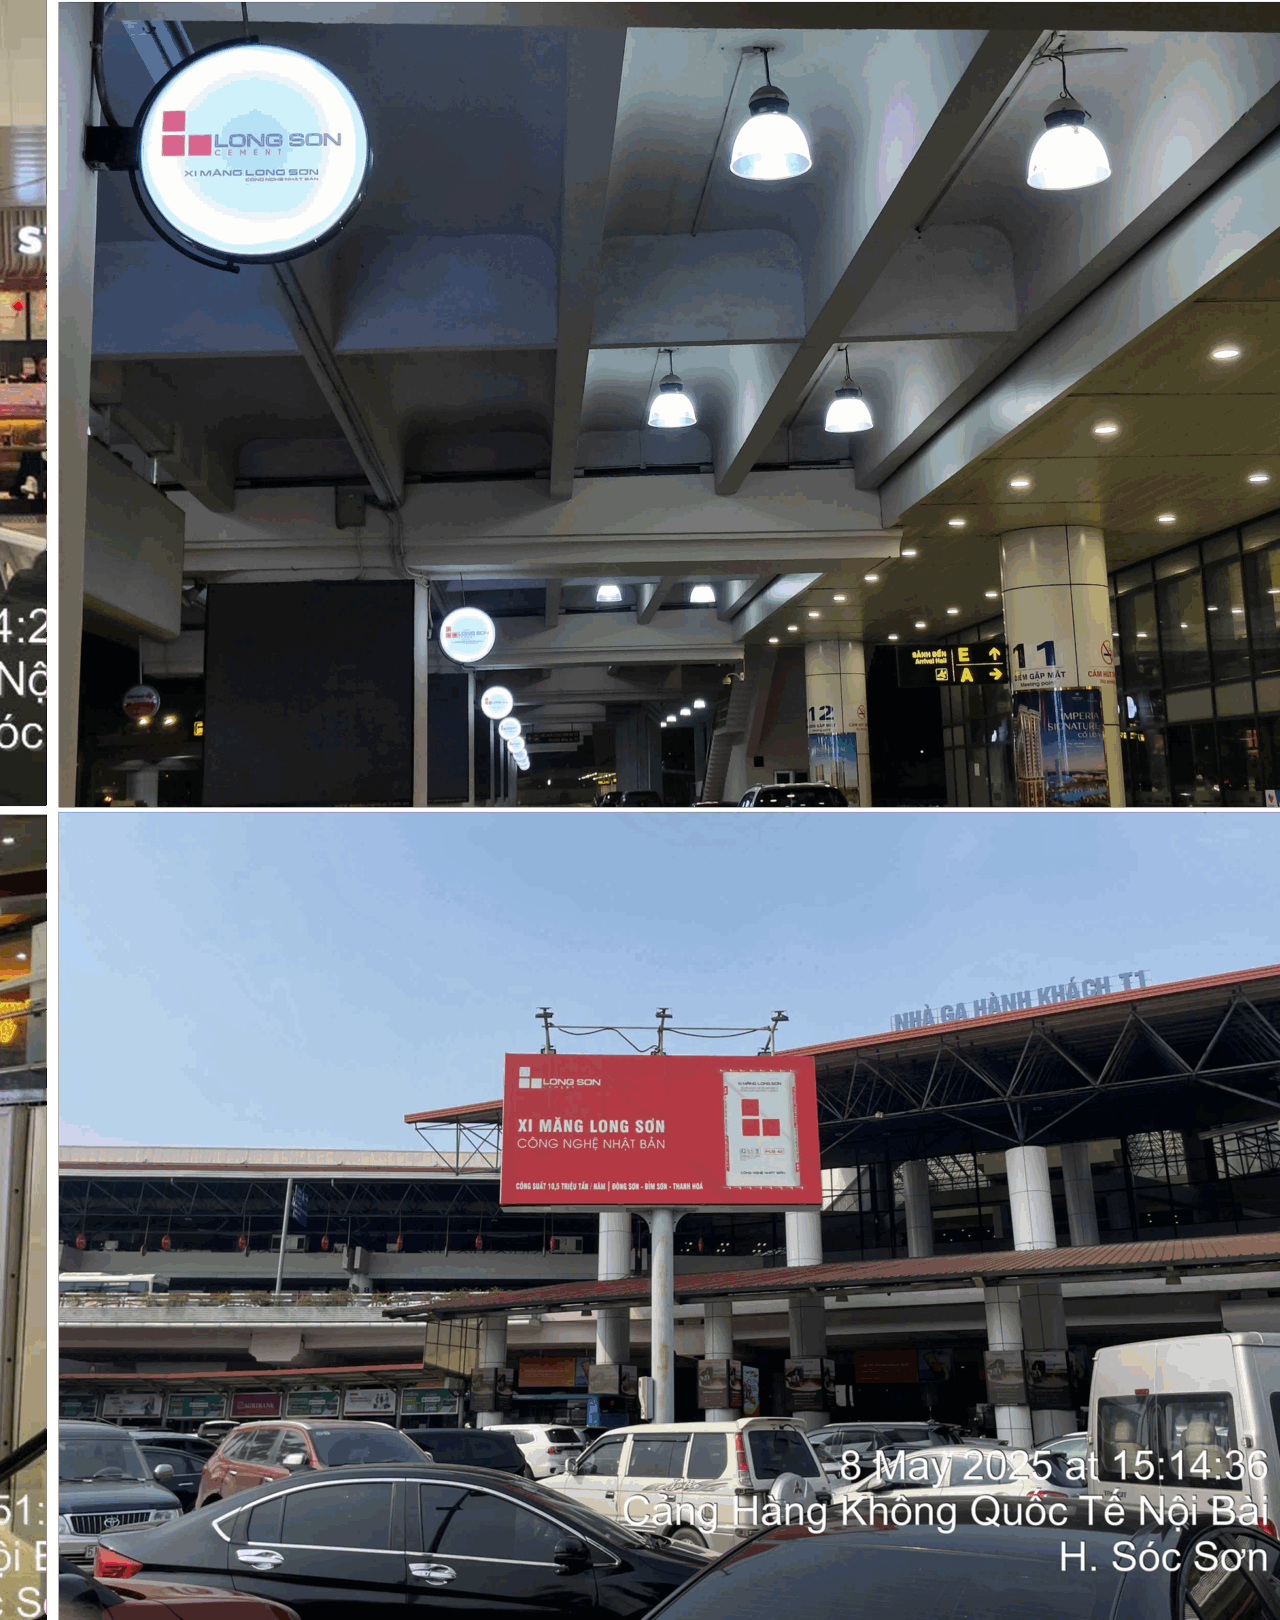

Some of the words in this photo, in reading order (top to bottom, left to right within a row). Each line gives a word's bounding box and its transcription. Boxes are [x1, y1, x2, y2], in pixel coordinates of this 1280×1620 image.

[214, 133, 283, 148] LONG
[289, 133, 342, 147] SON
[245, 169, 285, 177] LONG
[18, 225, 47, 254] S
[958, 647, 970, 662] E
[1013, 640, 1056, 669] 11
[960, 667, 974, 683] A
[809, 705, 835, 722] 12
[1061, 712, 1100, 720] IMPERIA
[1048, 721, 1100, 731] SIGNATURE
[895, 1004, 935, 1031] NHÀ
[941, 1002, 967, 1023] GA
[973, 991, 1031, 1017] HÀNH
[1038, 976, 1111, 1005] KHÁCH
[1119, 970, 1146, 991] T1
[543, 1078, 574, 1086] LONG
[576, 1078, 601, 1086] SON
[518, 1119, 533, 1133] XI
[539, 1116, 584, 1133] MĂNG
[590, 1119, 629, 1133] LONG
[635, 1118, 665, 1133] SƠN
[517, 1136, 559, 1149] CÔNG
[563, 1137, 598, 1151] NGHỆ
[603, 1137, 636, 1151] NHẬT
[640, 1136, 665, 1149] BẢN
[516, 1181, 532, 1190] CÔNG
[561, 1181, 577, 1191] TRIỆU
[612, 1181, 627, 1190] ĐÔNG
[673, 1182, 690, 1190] THANH
